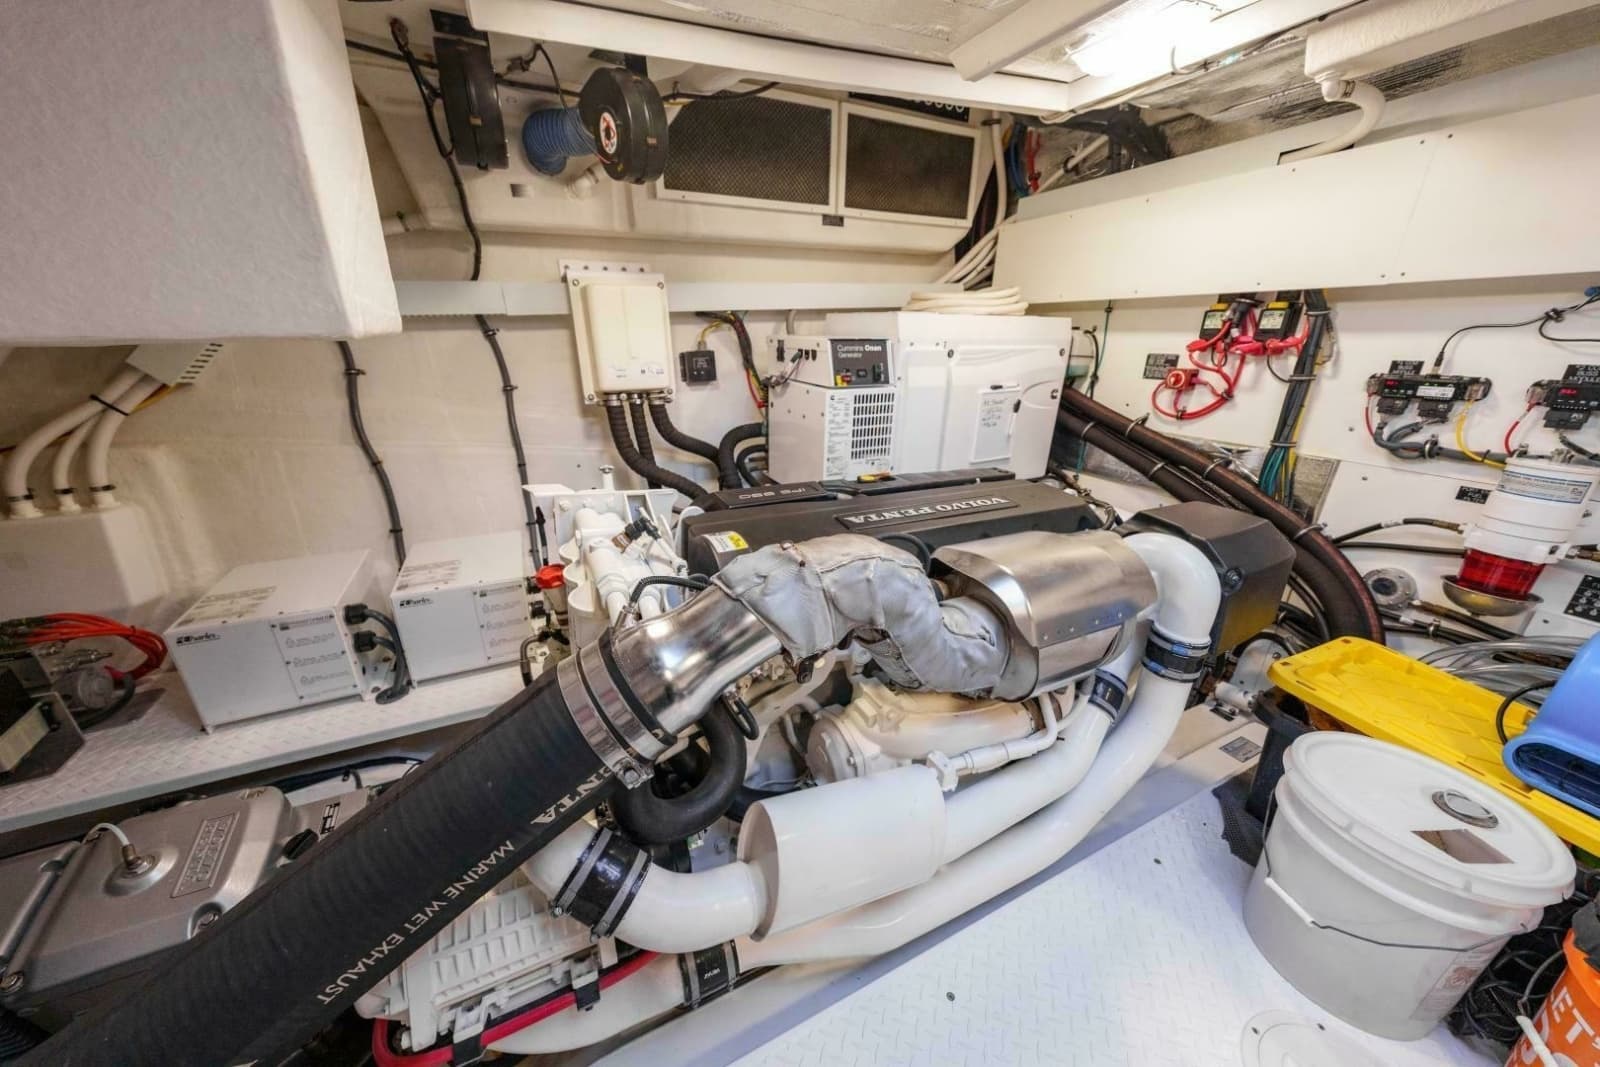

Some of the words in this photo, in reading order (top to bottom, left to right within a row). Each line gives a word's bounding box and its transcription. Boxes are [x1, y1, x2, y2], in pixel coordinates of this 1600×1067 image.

[844, 506, 937, 524] PENTA
[935, 497, 1009, 511] VOLVO
[529, 764, 613, 825] ENTA
[443, 840, 515, 899] MARINE
[403, 900, 448, 934] WET
[316, 932, 405, 1005] EXHAUST
